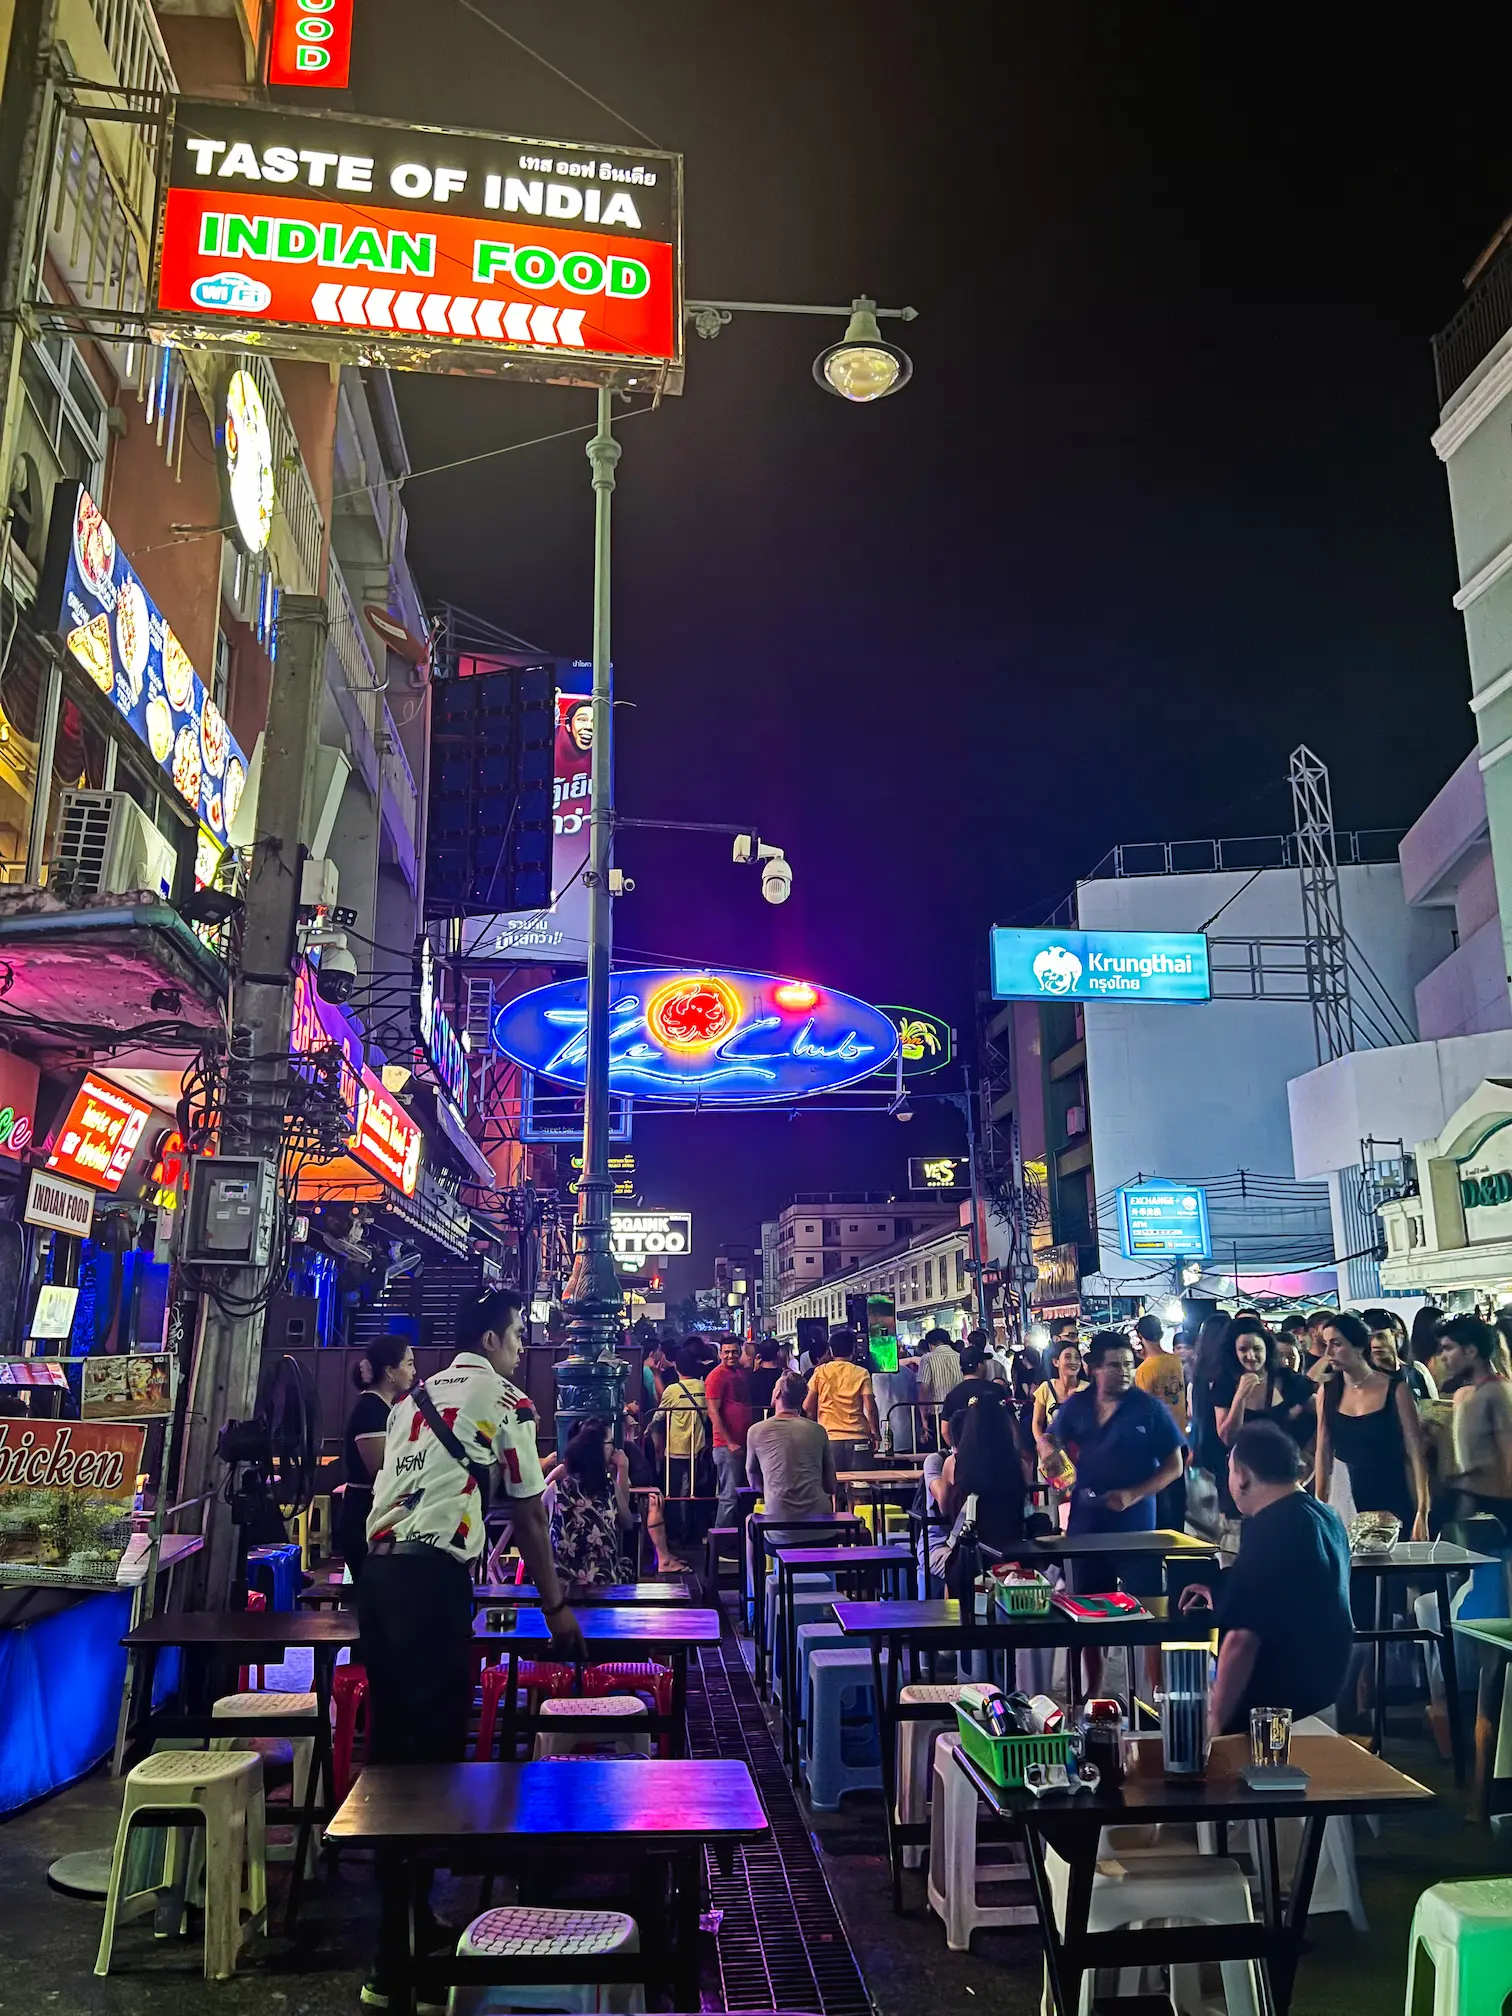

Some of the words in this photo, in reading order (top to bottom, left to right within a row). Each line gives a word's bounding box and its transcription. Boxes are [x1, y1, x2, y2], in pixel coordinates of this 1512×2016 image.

[186, 138, 375, 193] TASTE
[389, 161, 468, 203] OF
[484, 175, 642, 230] INDIA
[518, 155, 553, 174] เทส
[556, 160, 595, 179] ออฟ
[599, 162, 657, 187] อินเดีย
[198, 211, 437, 277] INDIAN
[473, 239, 650, 300] FOOD
[1088, 952, 1193, 978] Krungthai
[1089, 974, 1141, 994] กรุงไทย
[714, 1016, 876, 1062] Club
[924, 1159, 955, 1183] YES
[32, 1183, 66, 1218] INDIAN
[66, 1195, 90, 1224] FOOD
[1132, 1220, 1148, 1229] ATM
[609, 1232, 685, 1252] TTOO
